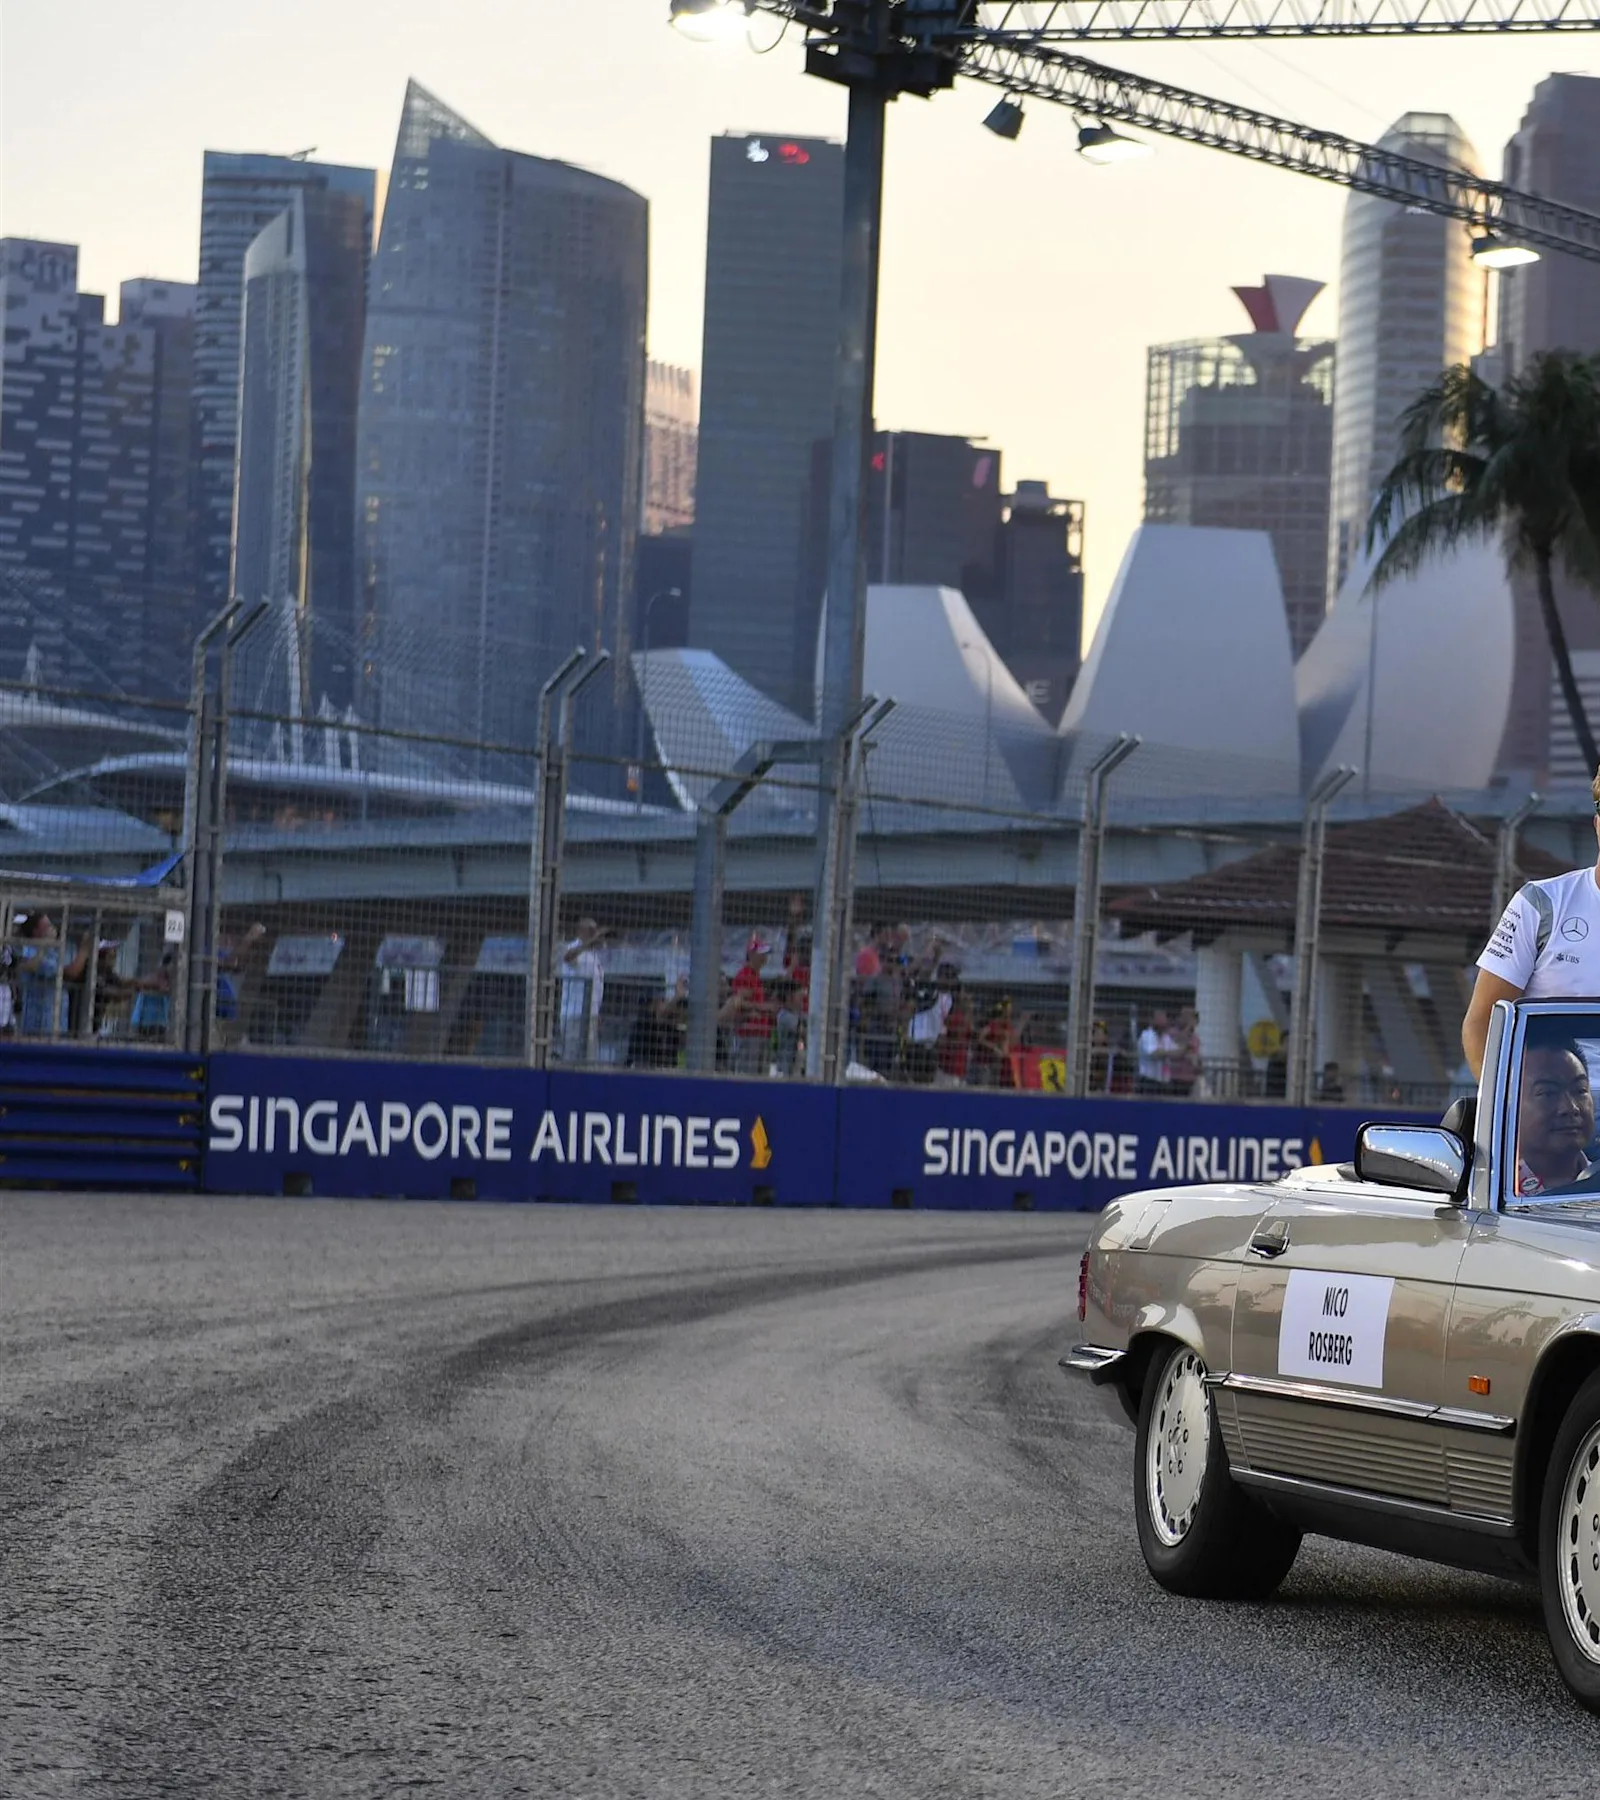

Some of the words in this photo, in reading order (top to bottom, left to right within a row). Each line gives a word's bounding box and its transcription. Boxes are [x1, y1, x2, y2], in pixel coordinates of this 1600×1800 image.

[1565, 954, 1580, 965] UBS
[209, 1094, 514, 1161] SINGAPORE
[530, 1109, 741, 1169] AIRLINES
[924, 1127, 1139, 1180] SINGAPORE
[1149, 1135, 1303, 1182] AIRLINES
[1322, 1286, 1349, 1318] NICO
[1308, 1331, 1353, 1366] ROSBERG
